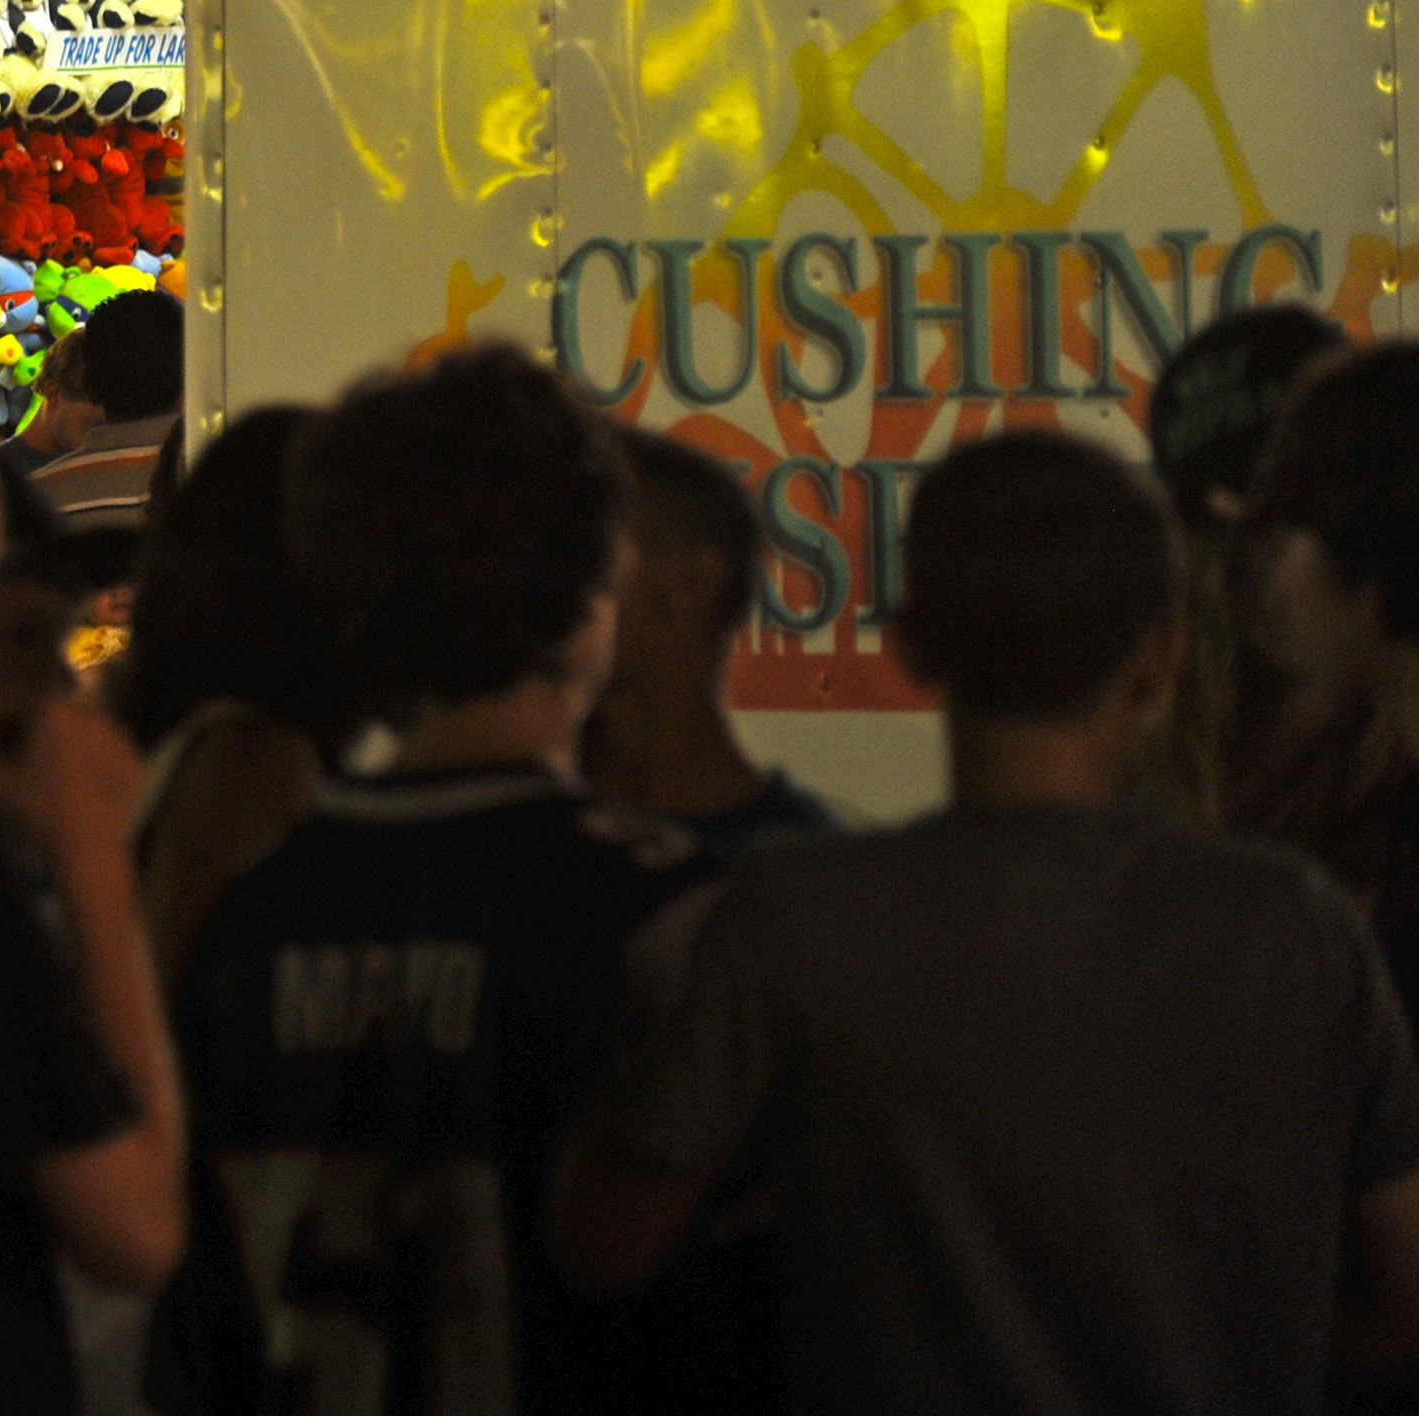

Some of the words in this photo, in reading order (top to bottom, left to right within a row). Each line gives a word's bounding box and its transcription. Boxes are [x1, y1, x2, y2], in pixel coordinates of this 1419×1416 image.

[59, 36, 104, 67] TRADE
[104, 35, 125, 64] UP
[125, 34, 152, 64] FOR
